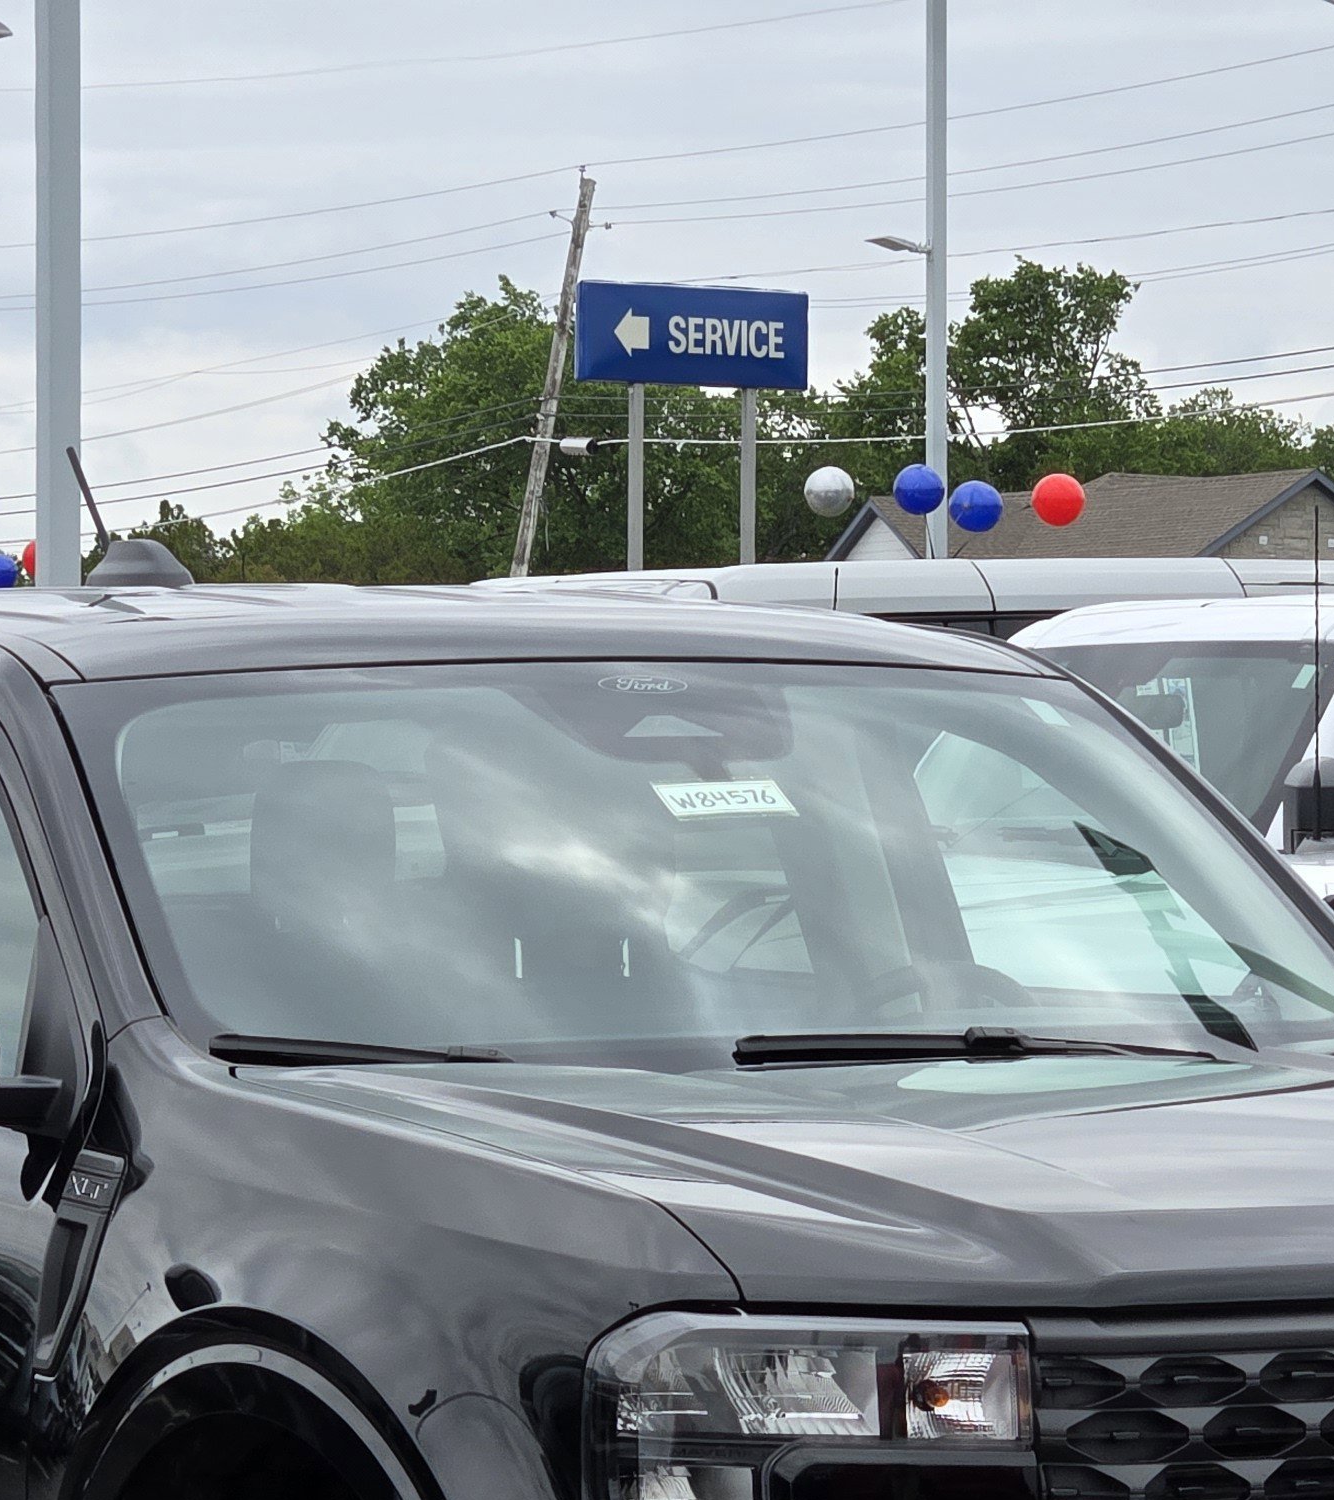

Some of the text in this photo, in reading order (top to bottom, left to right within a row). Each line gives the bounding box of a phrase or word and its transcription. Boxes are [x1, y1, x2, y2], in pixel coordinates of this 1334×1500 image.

[668, 315, 784, 359] SERVICE
[616, 675, 673, 691] Ford
[669, 789, 777, 809] W84576
[72, 1175, 108, 1199] XLT
